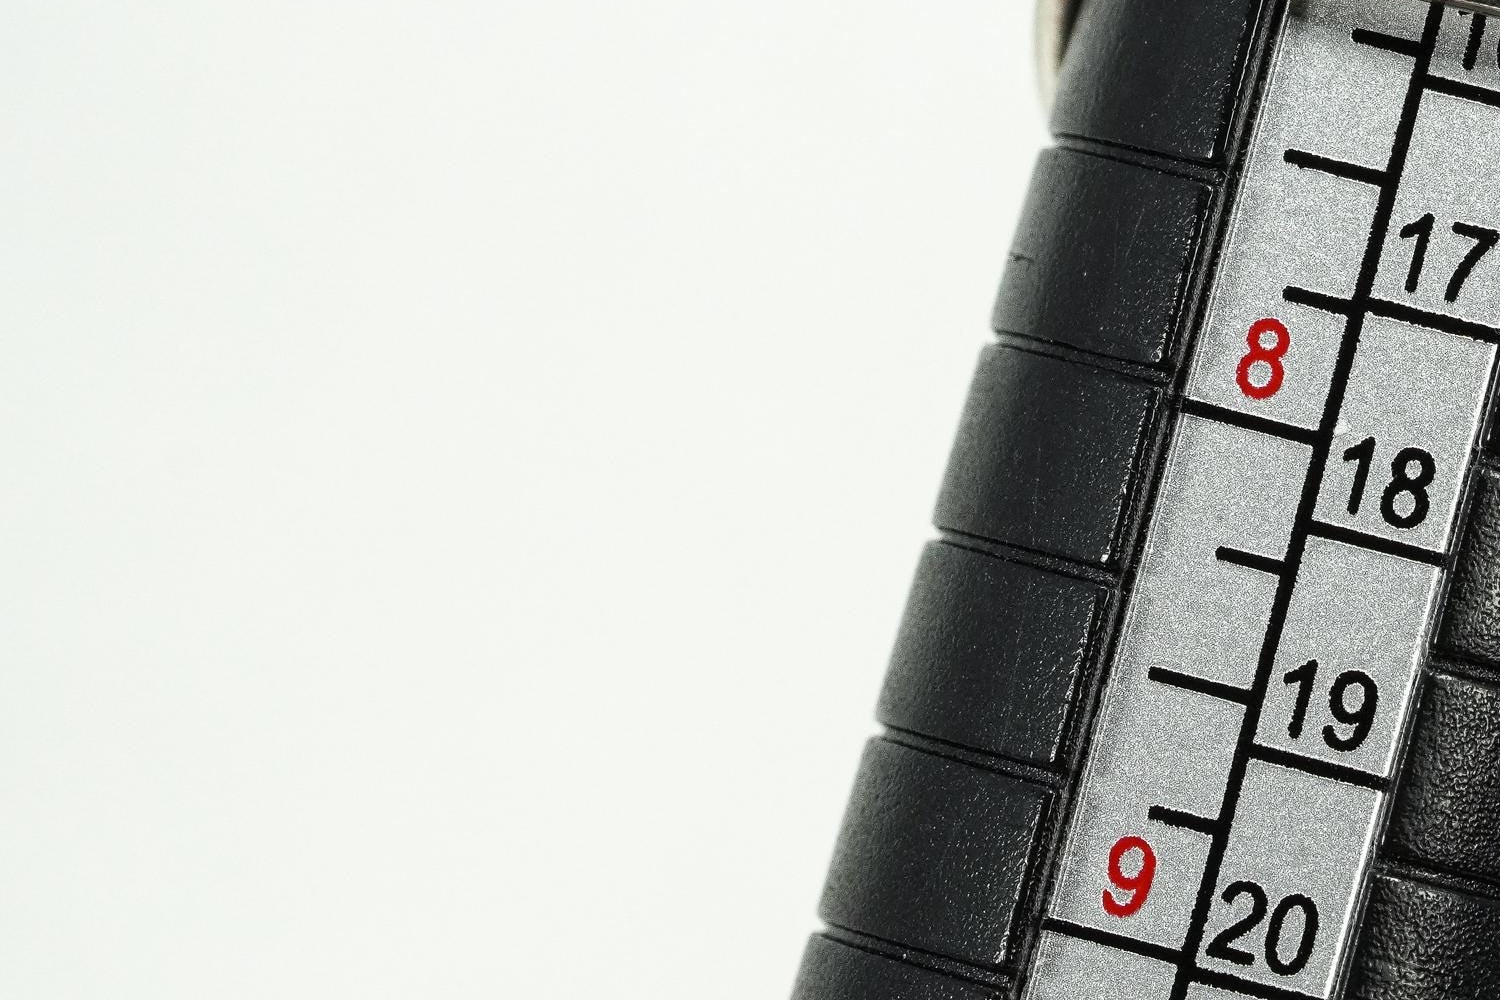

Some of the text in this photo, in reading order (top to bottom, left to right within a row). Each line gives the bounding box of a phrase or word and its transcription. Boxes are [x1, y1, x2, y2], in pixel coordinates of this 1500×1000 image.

[1398, 212, 1500, 304] 17
[1235, 317, 1291, 402] 8
[1342, 436, 1437, 530] 18
[1282, 658, 1380, 753] 19
[1102, 835, 1157, 919] 9
[1204, 880, 1321, 977] 20
